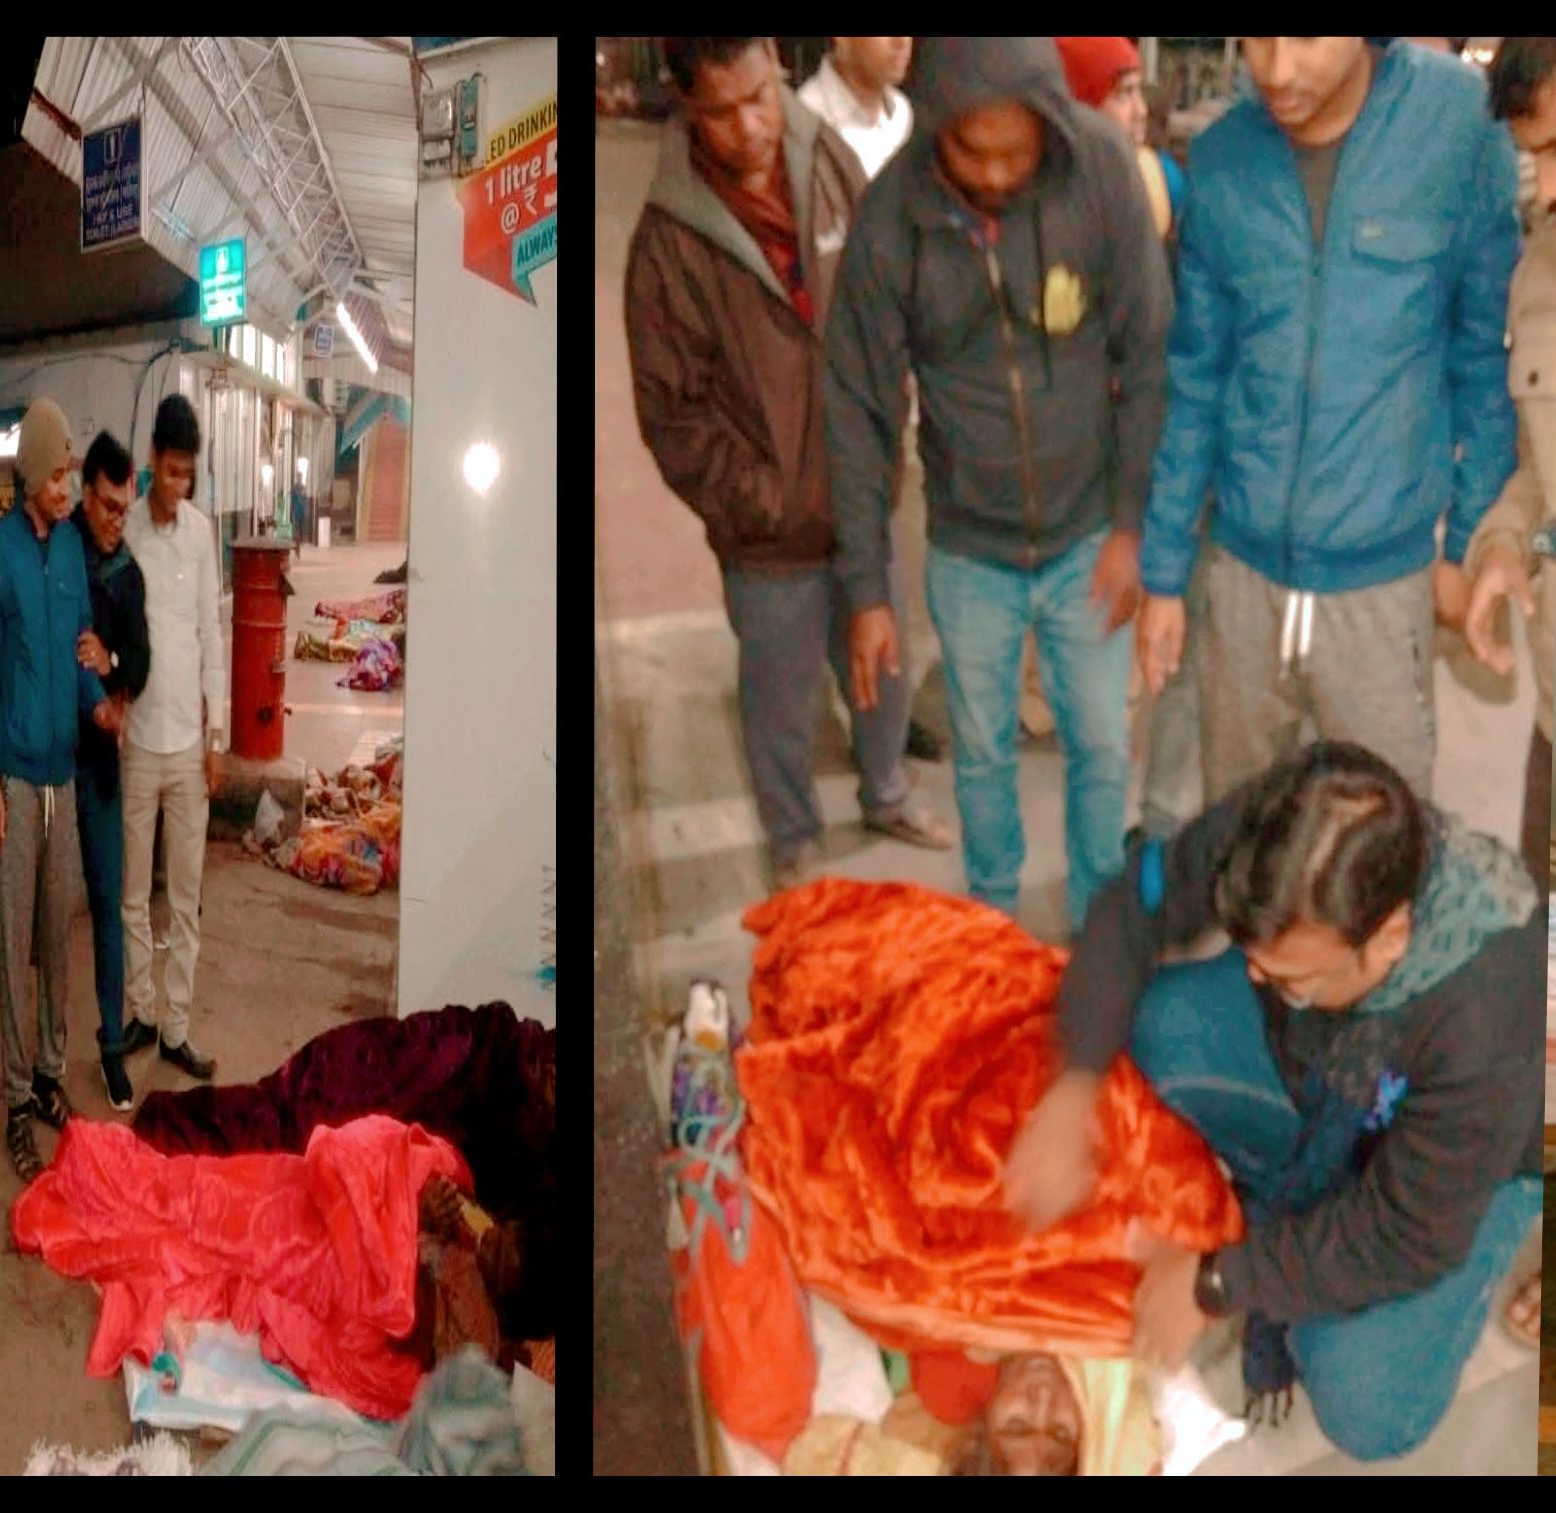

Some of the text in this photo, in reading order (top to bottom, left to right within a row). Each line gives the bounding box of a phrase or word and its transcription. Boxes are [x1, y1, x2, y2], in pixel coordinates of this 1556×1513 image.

[486, 135, 506, 164] ED
[485, 176, 495, 206] 1
[500, 155, 543, 199] litre
[501, 202, 520, 234] @
